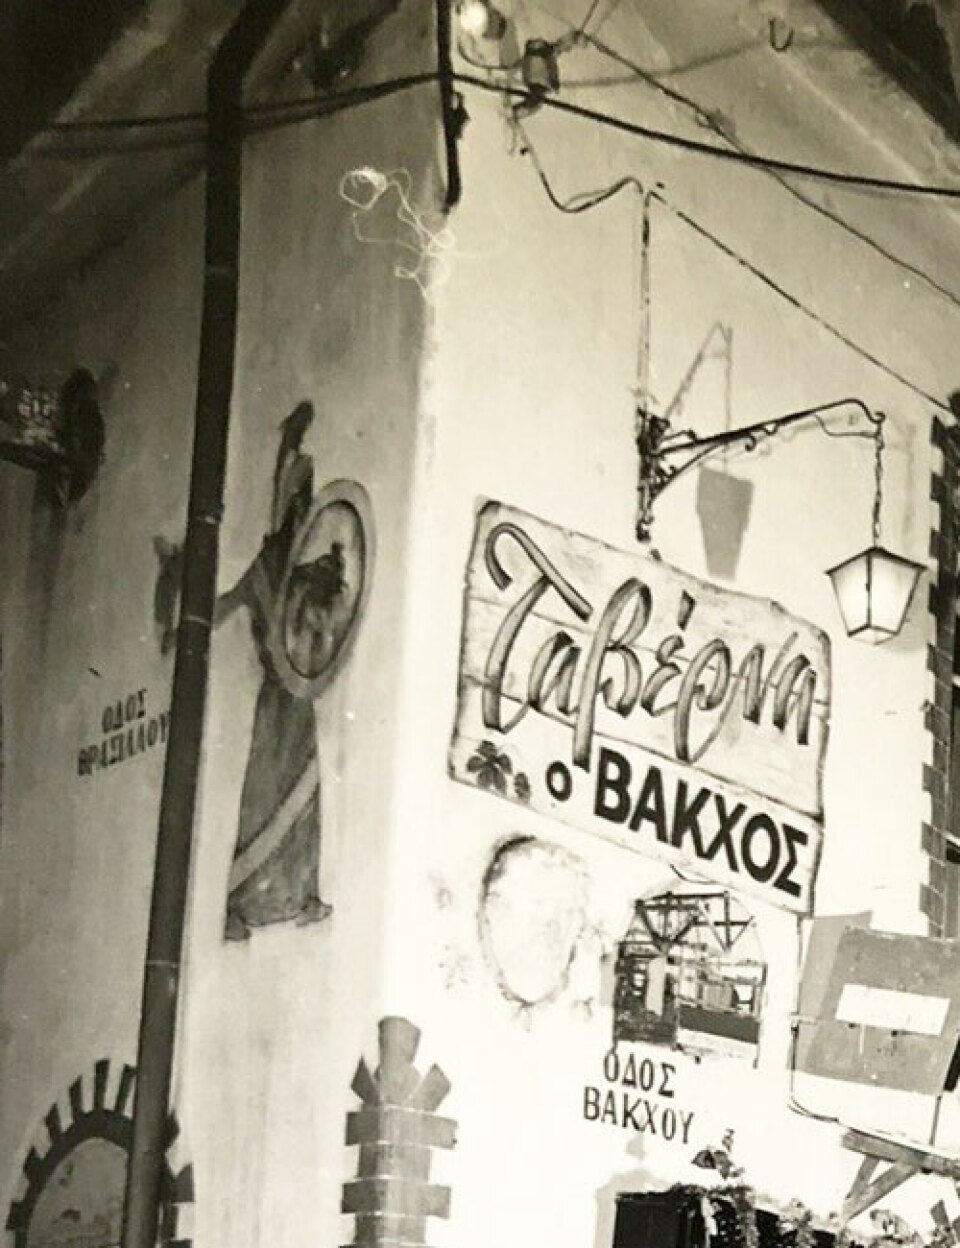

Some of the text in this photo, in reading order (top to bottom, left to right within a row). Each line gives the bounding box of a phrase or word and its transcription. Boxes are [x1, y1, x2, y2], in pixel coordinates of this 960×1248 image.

[483, 521, 817, 773] Ταβέρνα
[102, 687, 147, 733] ΟΔΟΣ
[594, 745, 809, 898] ΒΑΚΧΟΣ
[602, 1051, 677, 1099] ΟΔΟΣ
[583, 1086, 695, 1145] ΒΑΚΧΟΥ
